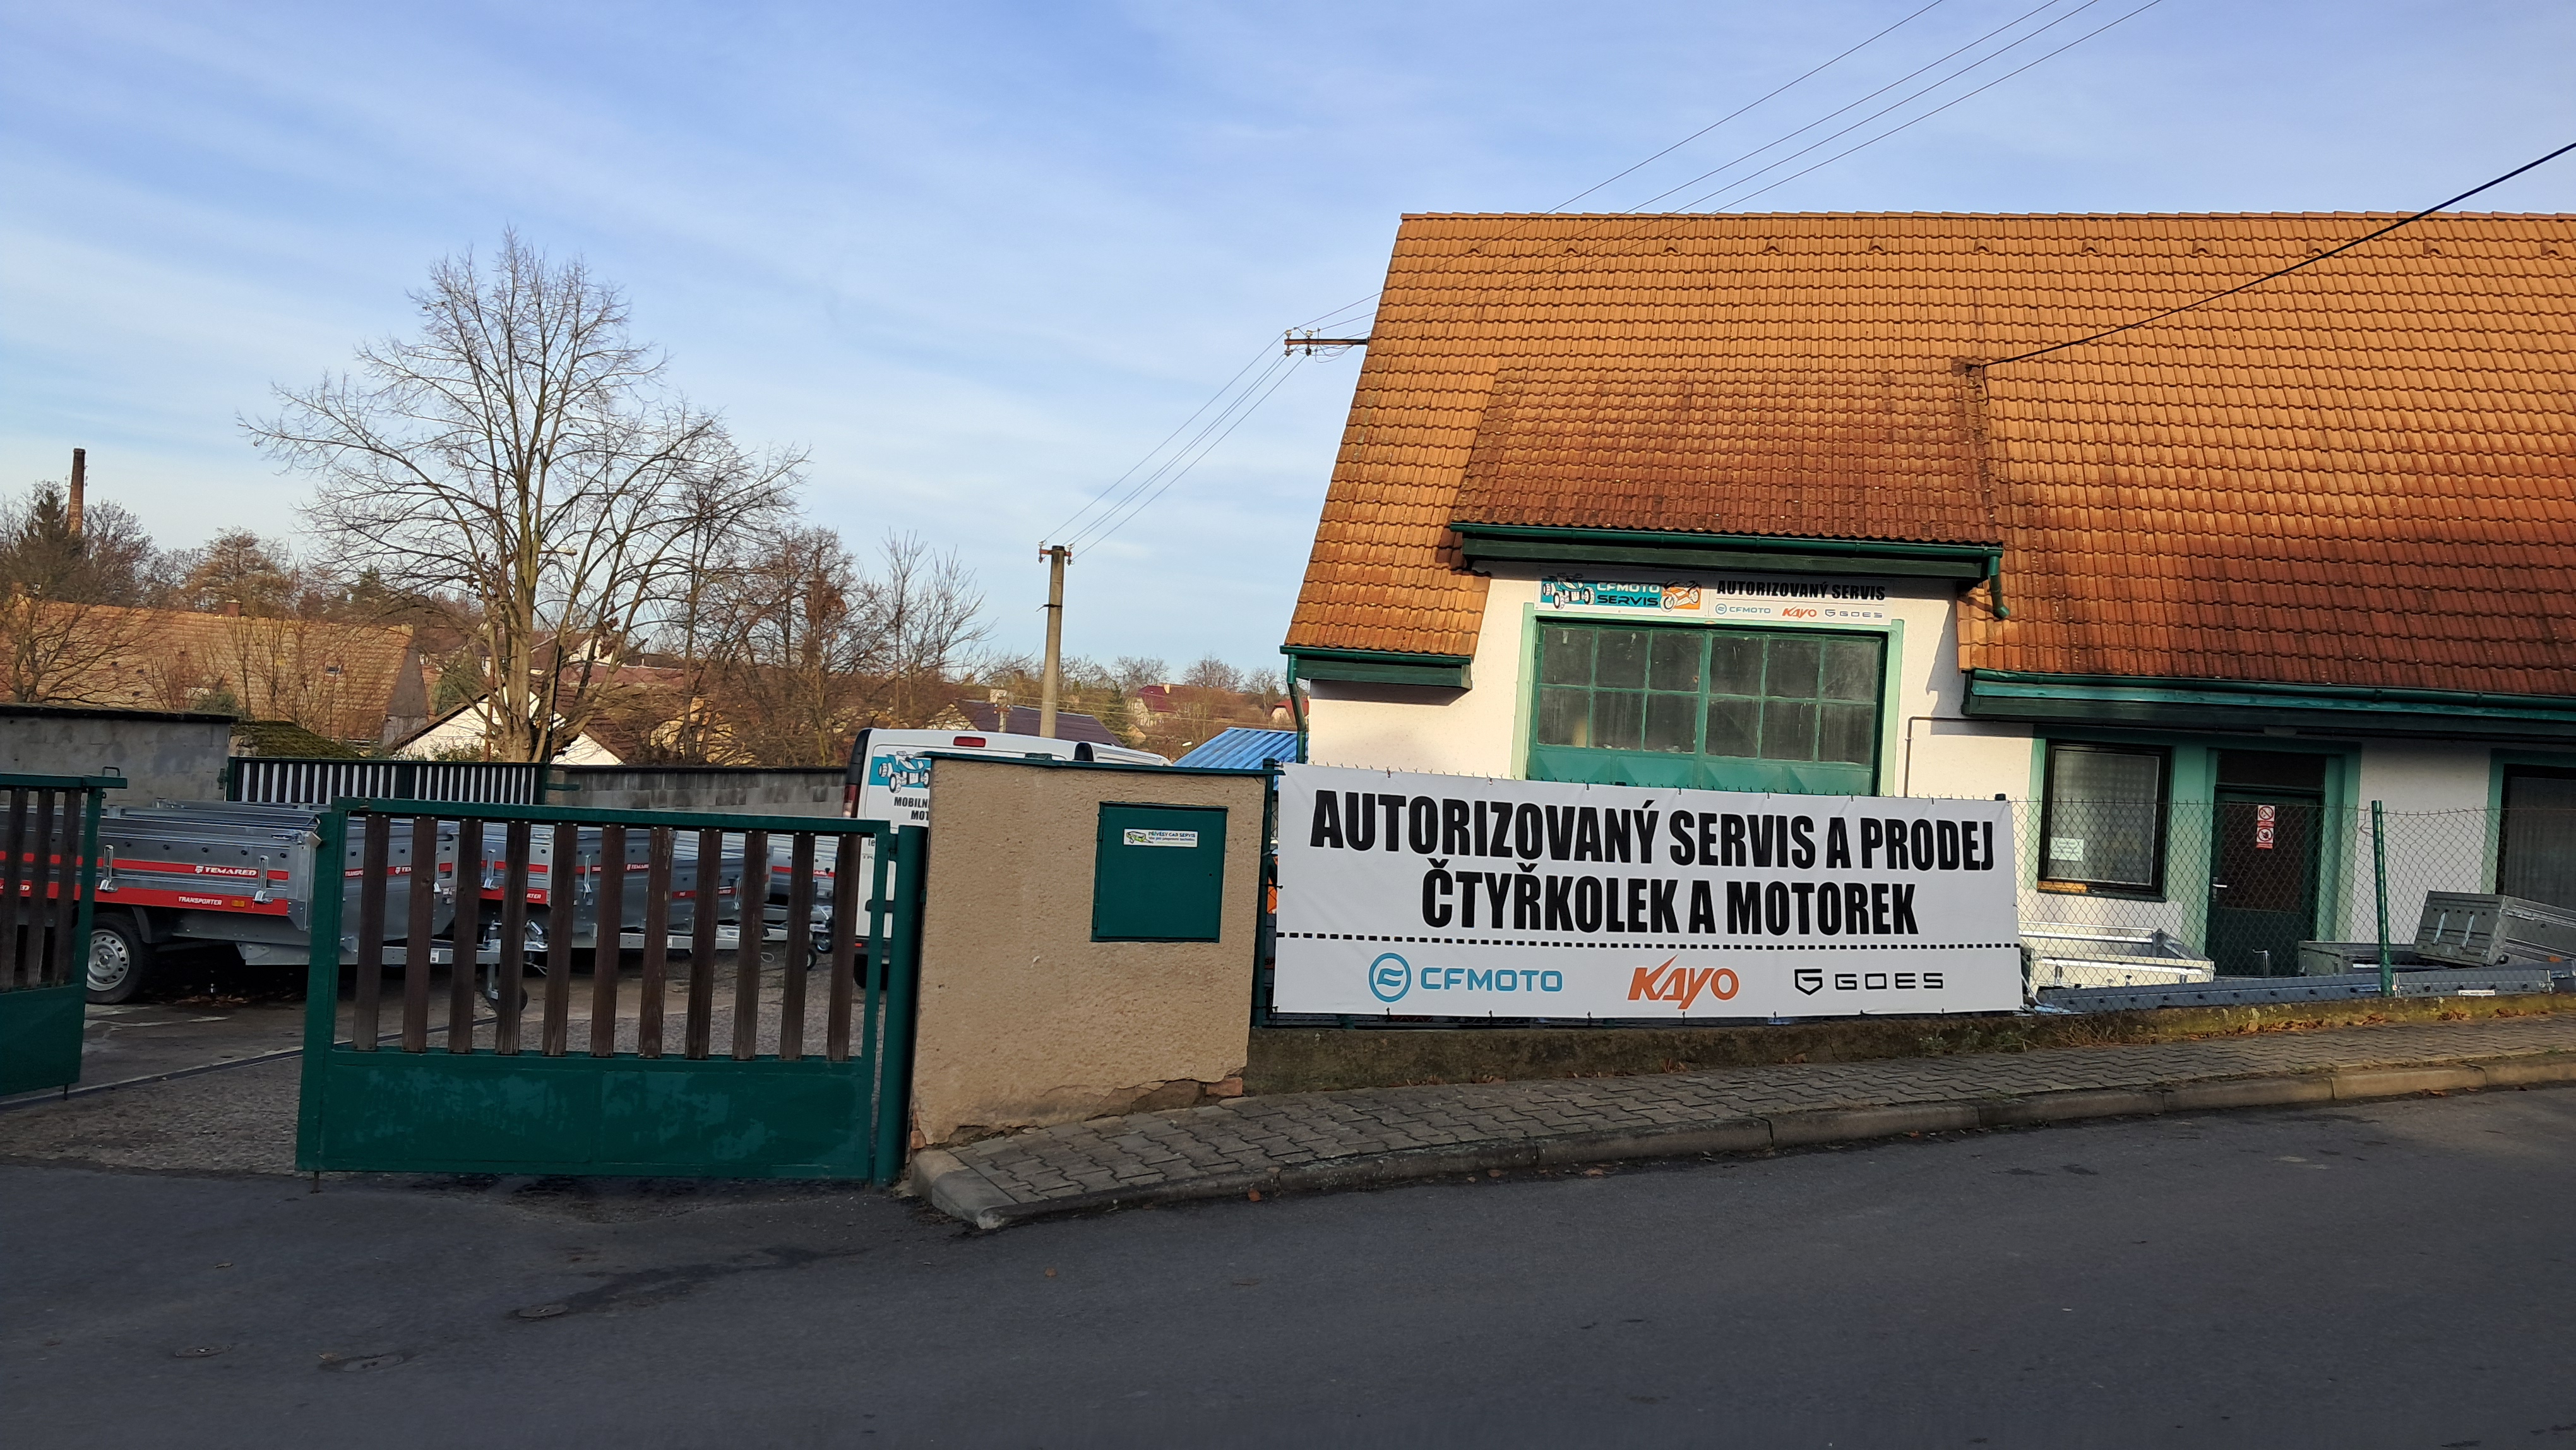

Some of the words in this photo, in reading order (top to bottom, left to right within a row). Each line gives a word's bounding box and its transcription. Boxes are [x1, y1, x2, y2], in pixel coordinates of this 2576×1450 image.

[1597, 582, 1660, 593] CFMOTO
[1717, 580, 1828, 599] AUTORIZOVANÝ
[1832, 585, 1885, 601] SERVIS
[1597, 594, 1659, 606] SERVIS
[1782, 605, 1817, 620] KAYO
[894, 796, 929, 808] MOBILN
[1310, 790, 1659, 864] AUTORIZOVANÝ
[1669, 810, 1816, 869] SERVIS
[1827, 817, 1852, 869] A
[1860, 817, 1994, 871] PRODEJ
[205, 866, 257, 876] TEMARED
[178, 896, 222, 906] TRANSPORTER
[1422, 858, 1679, 933] ČTYŘKOLEK
[1689, 880, 1716, 934] A
[1726, 881, 1919, 935] MOTOREK
[1421, 967, 1563, 992] CFMOTO
[1628, 954, 1739, 1010] KAYO
[1835, 973, 1944, 990] GOES
